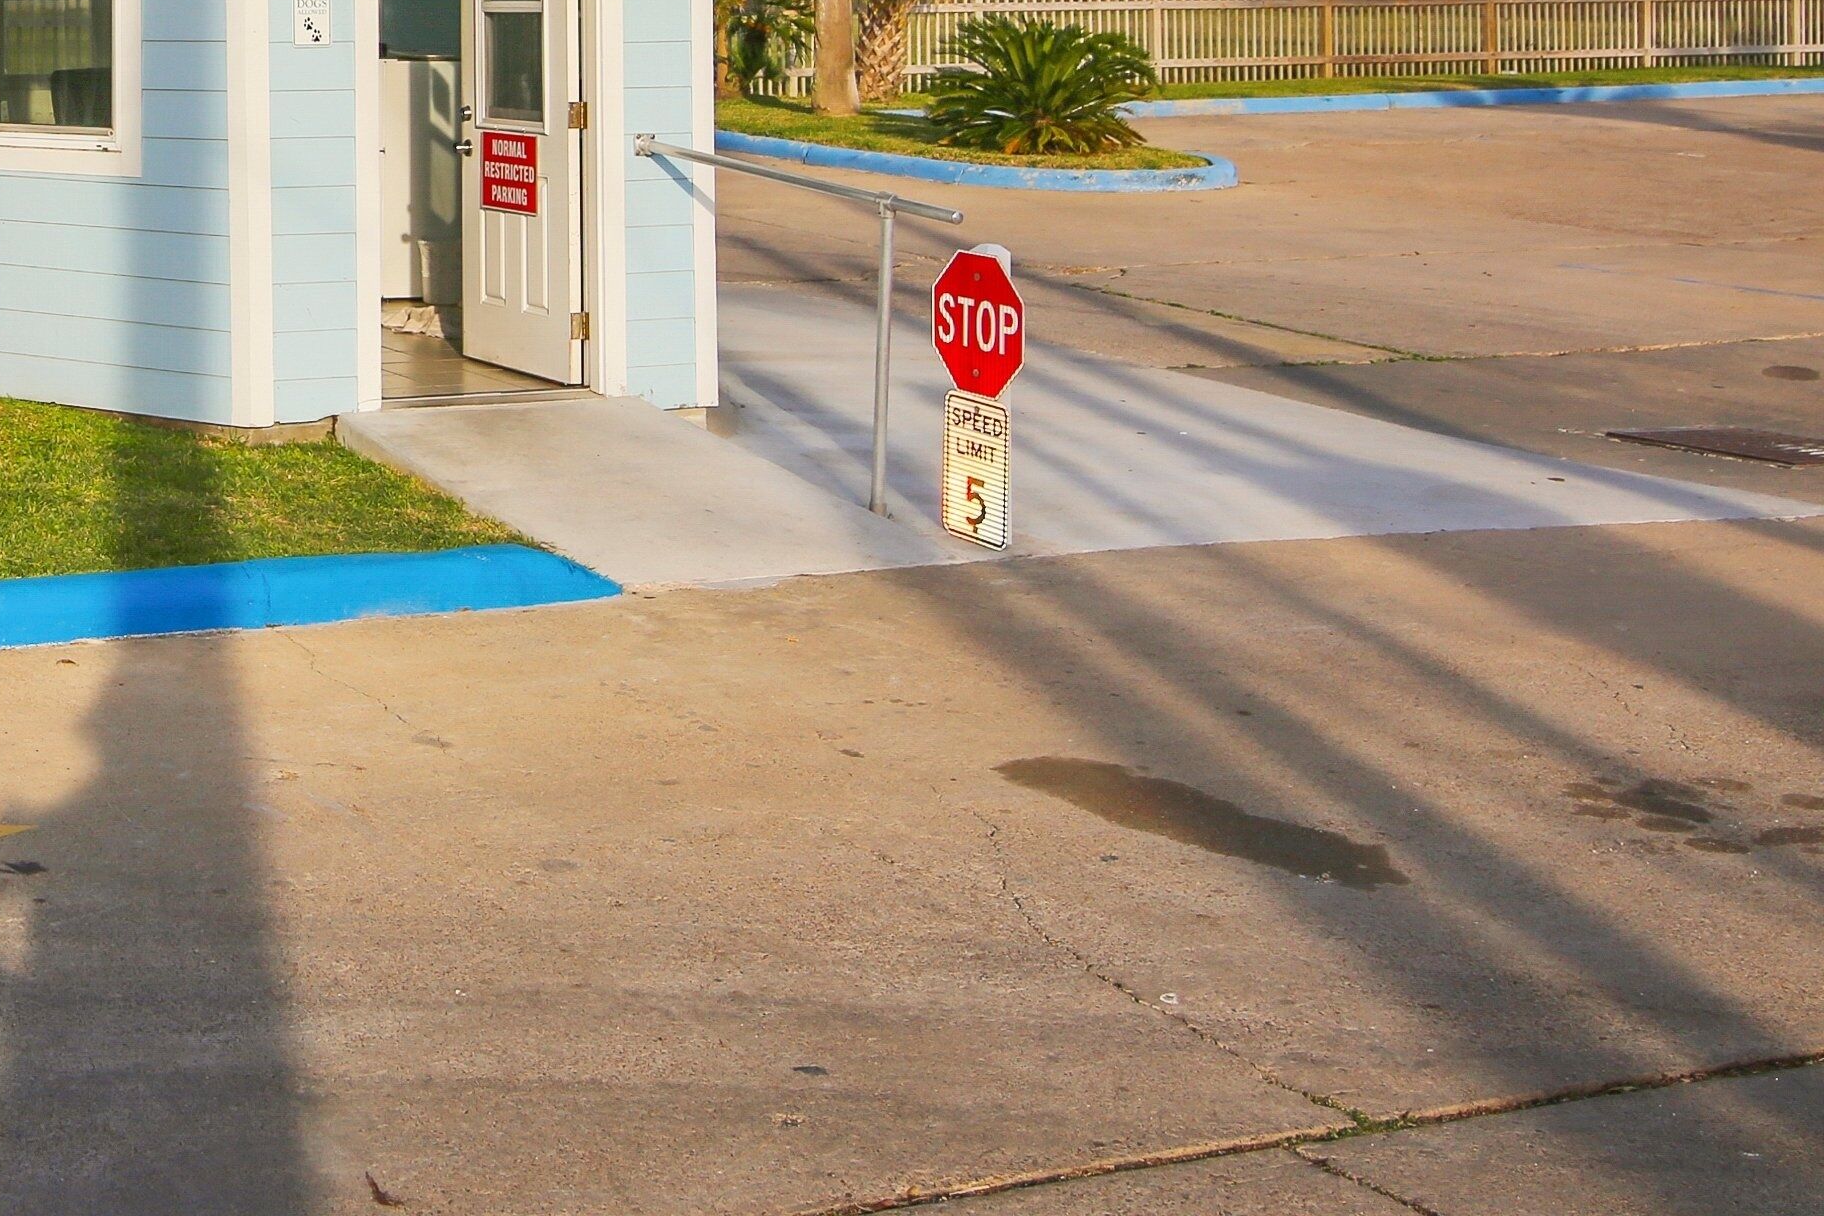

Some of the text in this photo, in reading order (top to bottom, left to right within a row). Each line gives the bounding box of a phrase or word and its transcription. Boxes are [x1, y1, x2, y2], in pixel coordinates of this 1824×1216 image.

[492, 139, 527, 159] NORMAL
[484, 160, 535, 183] RESTRICTED
[491, 184, 528, 206] PARKING
[938, 292, 1019, 355] STOP
[952, 407, 1003, 437] SPEED
[956, 437, 996, 463] LIMIT
[966, 475, 986, 526] 5
